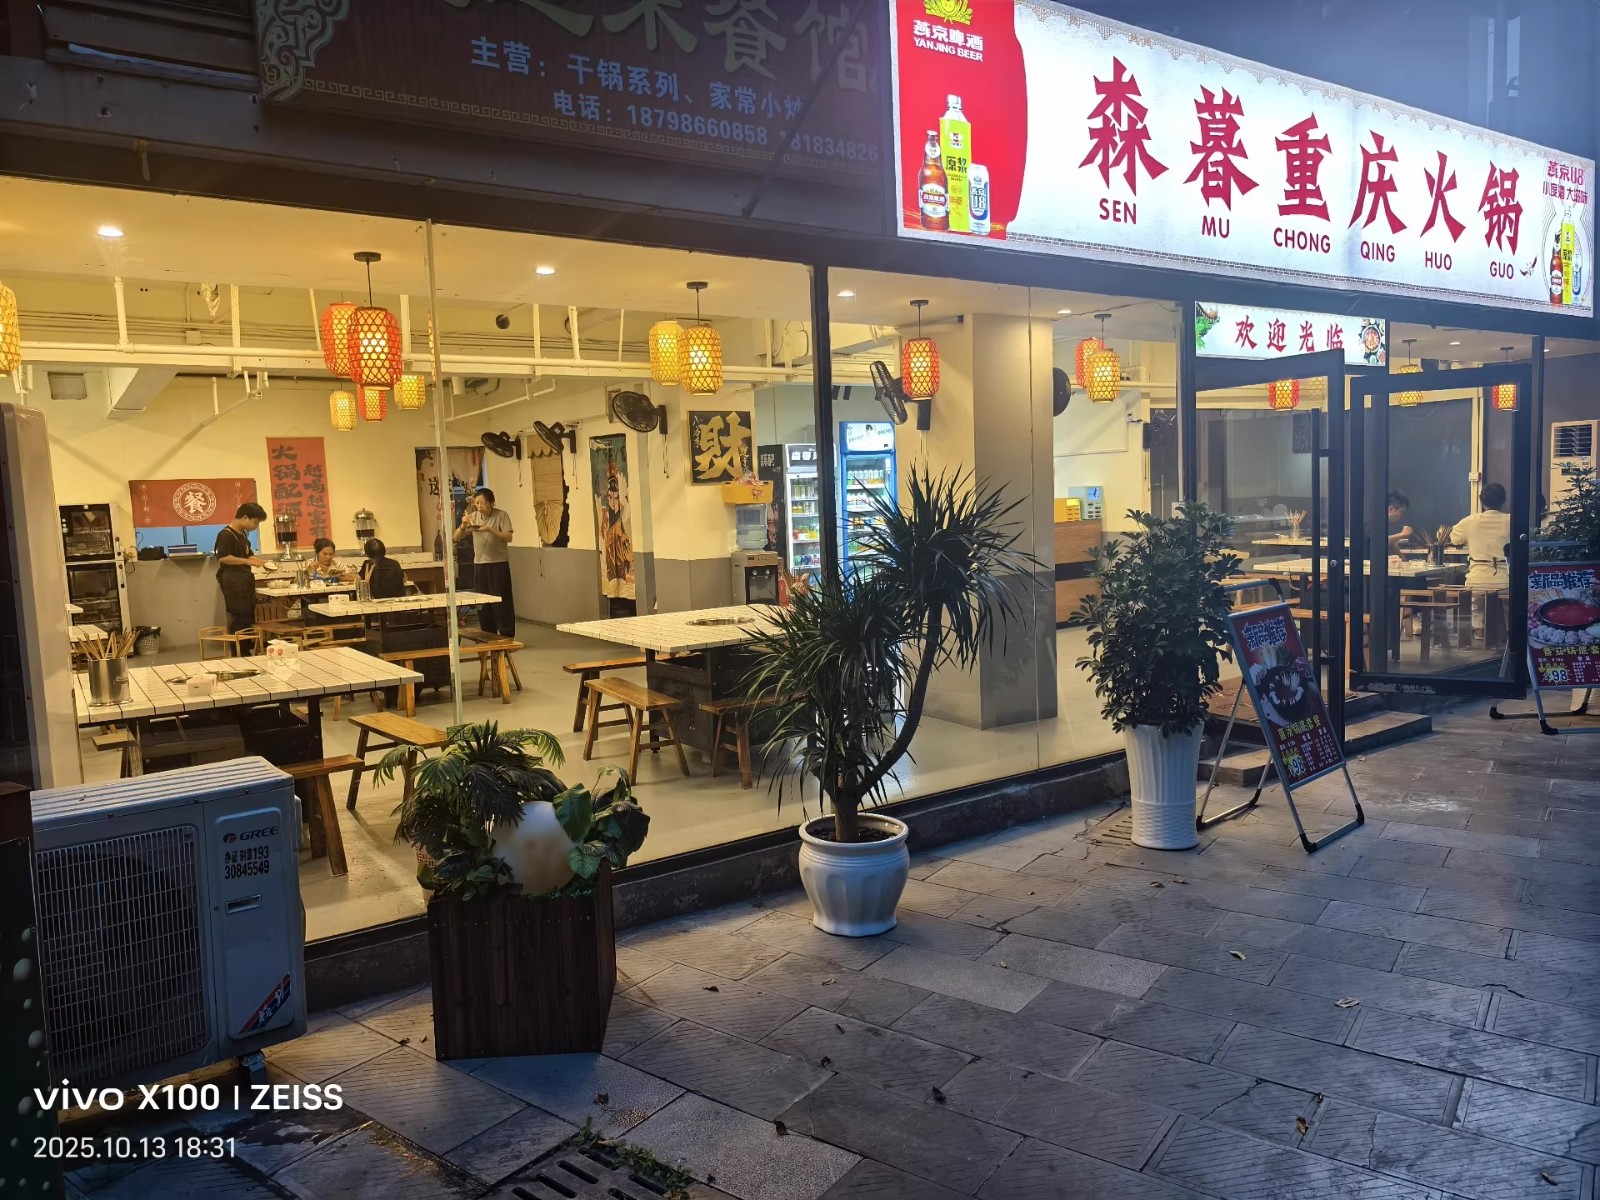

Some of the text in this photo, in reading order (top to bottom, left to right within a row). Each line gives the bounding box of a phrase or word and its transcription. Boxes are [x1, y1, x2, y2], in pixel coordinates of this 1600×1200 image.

[913, 20, 984, 51] 燕京啤酒
[914, 37, 984, 61] YANJING BEER
[1078, 56, 1524, 256] 森暮重庆火锅
[1547, 160, 1585, 186] 燕京U8
[1099, 198, 1515, 280] SEN MU CHONG QING HUO GUO
[1235, 315, 1344, 353] 欢迎光临
[184, 491, 207, 514] 餐
[240, 827, 279, 840] GREE
[225, 860, 269, 879] 30845549
